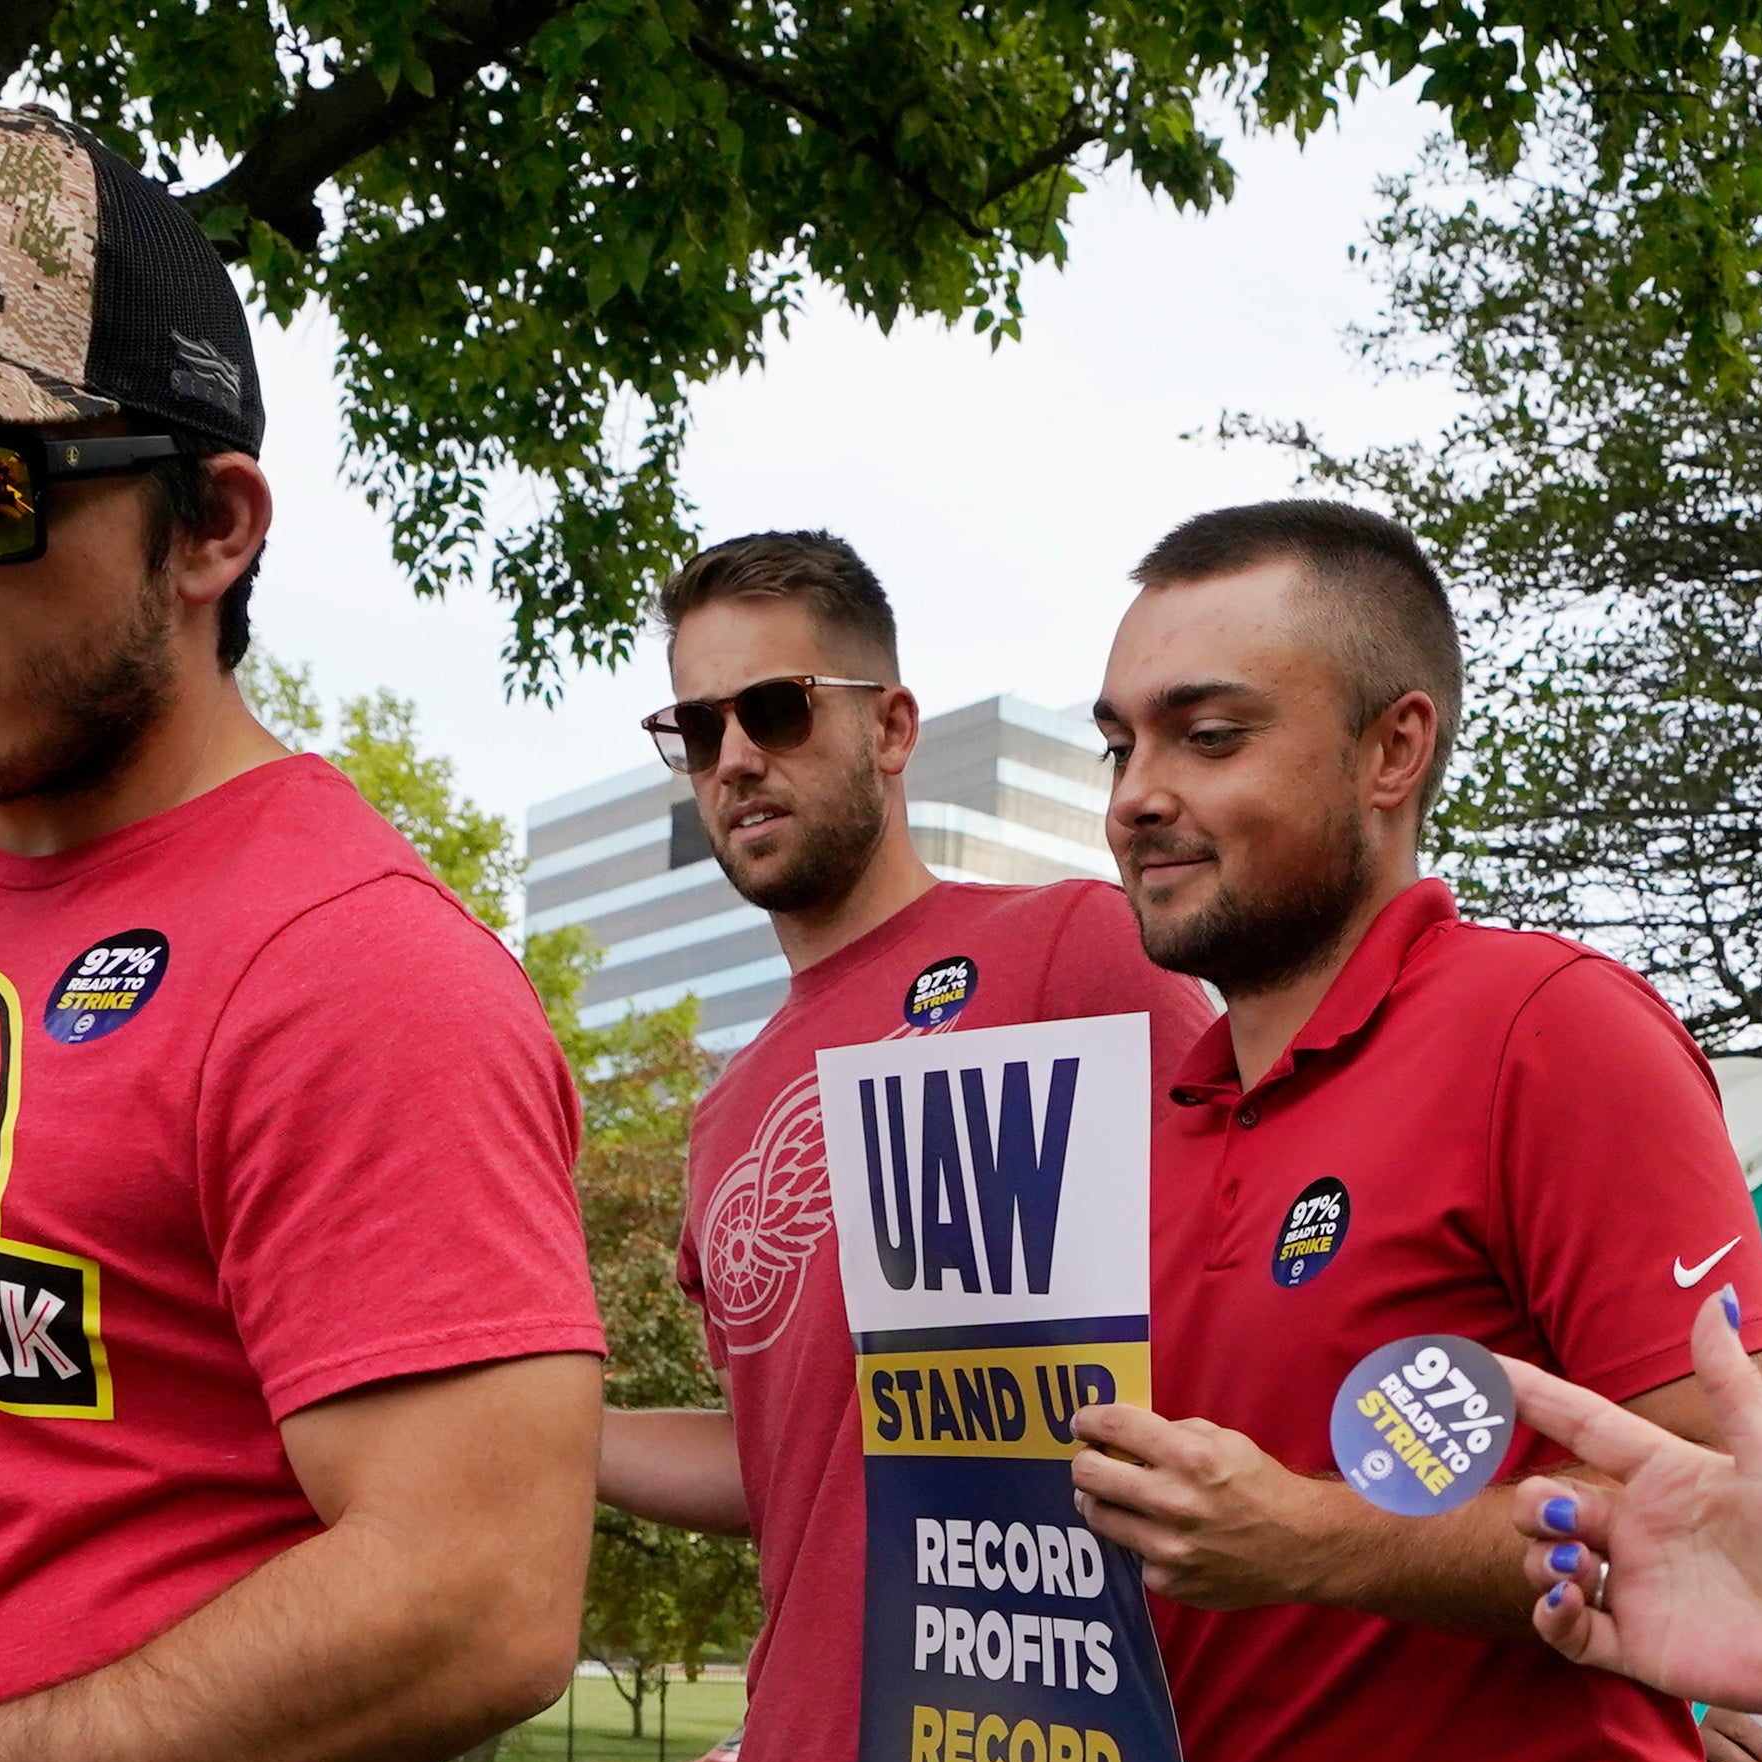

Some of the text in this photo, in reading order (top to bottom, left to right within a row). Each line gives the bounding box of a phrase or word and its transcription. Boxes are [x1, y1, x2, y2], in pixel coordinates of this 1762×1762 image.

[78, 946, 162, 976] 97%
[916, 961, 968, 994] 97%
[56, 992, 138, 1010] STRIKE
[66, 977, 146, 991] READY TO
[912, 988, 965, 1014] STRIKE
[914, 979, 967, 1004] READY TO
[859, 1057, 1080, 1295] UAW
[1290, 1192, 1342, 1229] 97%
[1279, 1236, 1333, 1261] STRIKE
[1284, 1222, 1337, 1244] READY TO
[871, 1366, 1026, 1441] STAND
[1402, 1347, 1505, 1454] 97%
[1379, 1373, 1471, 1474] READY TO
[1357, 1390, 1455, 1497] STRIKE
[915, 1518, 1105, 1599] RECORD
[914, 1605, 1118, 1695] PROFITS
